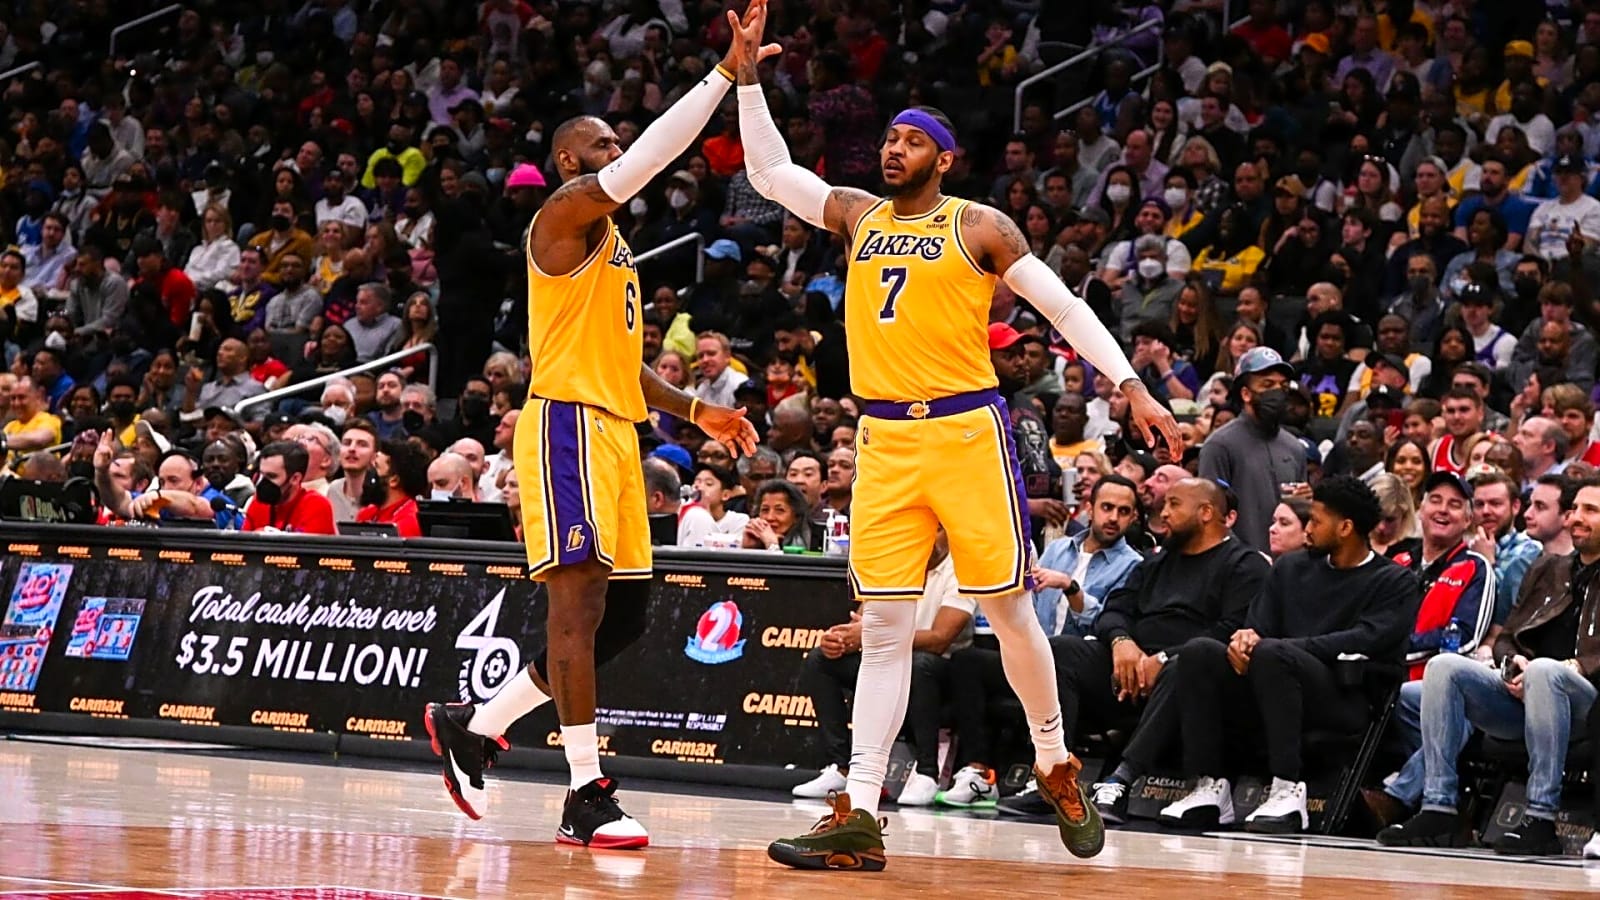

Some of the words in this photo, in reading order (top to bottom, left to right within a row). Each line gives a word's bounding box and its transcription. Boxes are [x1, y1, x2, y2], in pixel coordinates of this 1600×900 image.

[856, 230, 946, 261] LAKERS
[626, 281, 636, 331] 6
[880, 267, 907, 319] 7
[189, 586, 261, 623] Total
[255, 593, 311, 626] cash
[304, 598, 382, 633] prizes
[382, 605, 437, 633] over
[701, 605, 733, 651] 2
[176, 631, 249, 676] $3.5
[252, 638, 428, 688] MILLION!
